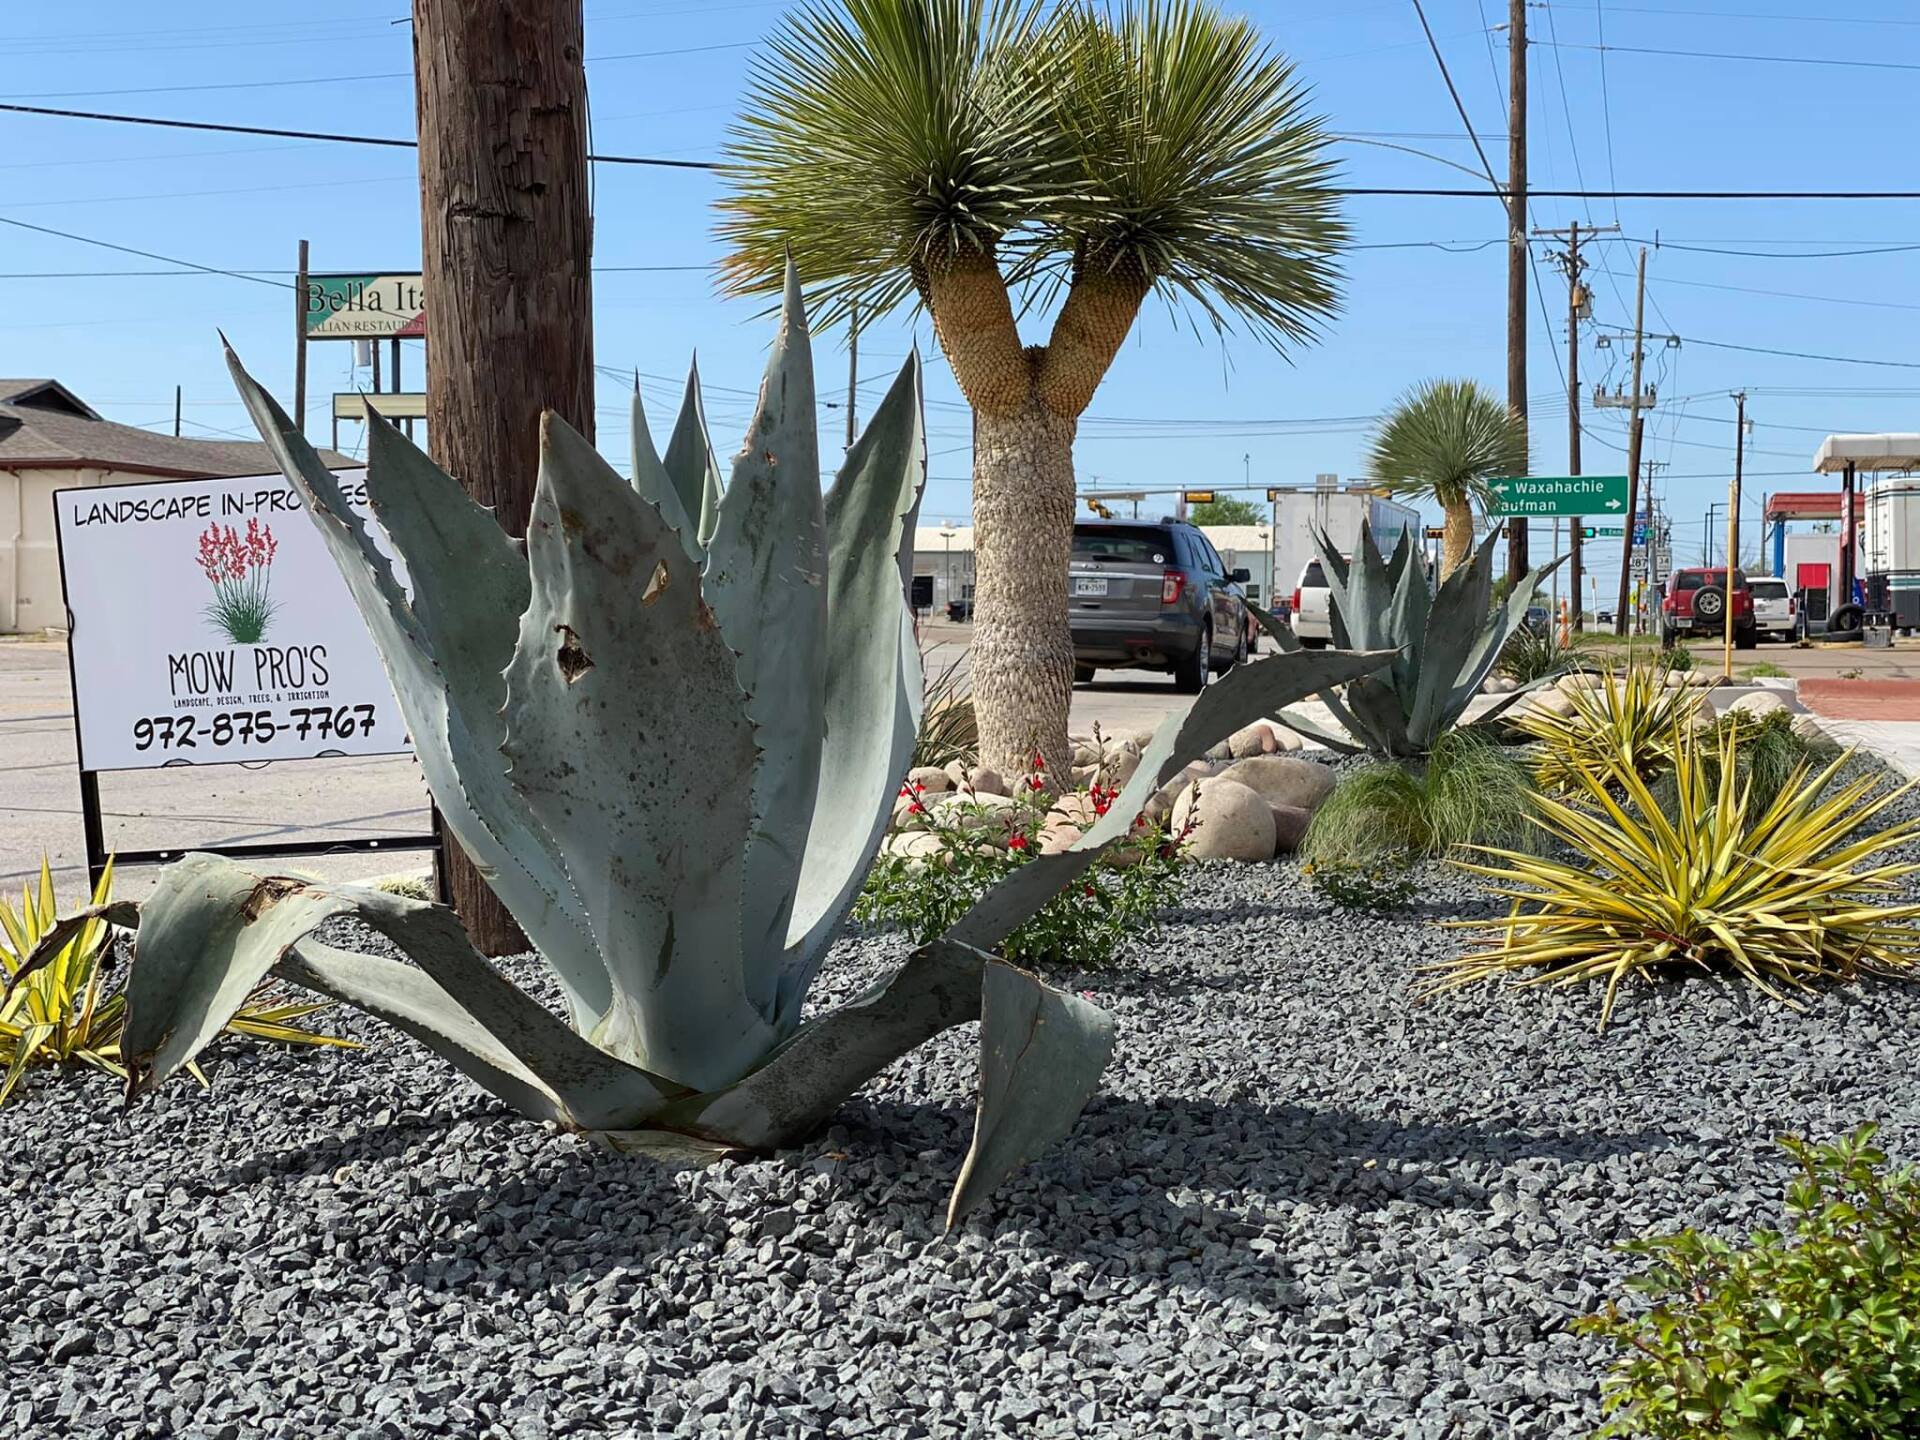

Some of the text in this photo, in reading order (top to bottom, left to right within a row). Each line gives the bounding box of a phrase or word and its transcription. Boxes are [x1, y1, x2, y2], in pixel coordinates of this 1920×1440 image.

[306, 280, 382, 312] Bella
[1515, 480, 1604, 494] Waxahachie
[74, 495, 211, 526] LANDSCAPE
[1500, 499, 1557, 512] aufman
[168, 645, 329, 696] MOW PRO'S
[174, 690, 330, 709] LANDSCAPE, DESIGN, TREES, & IRRIGATION
[133, 704, 376, 751] 972-875-7767
